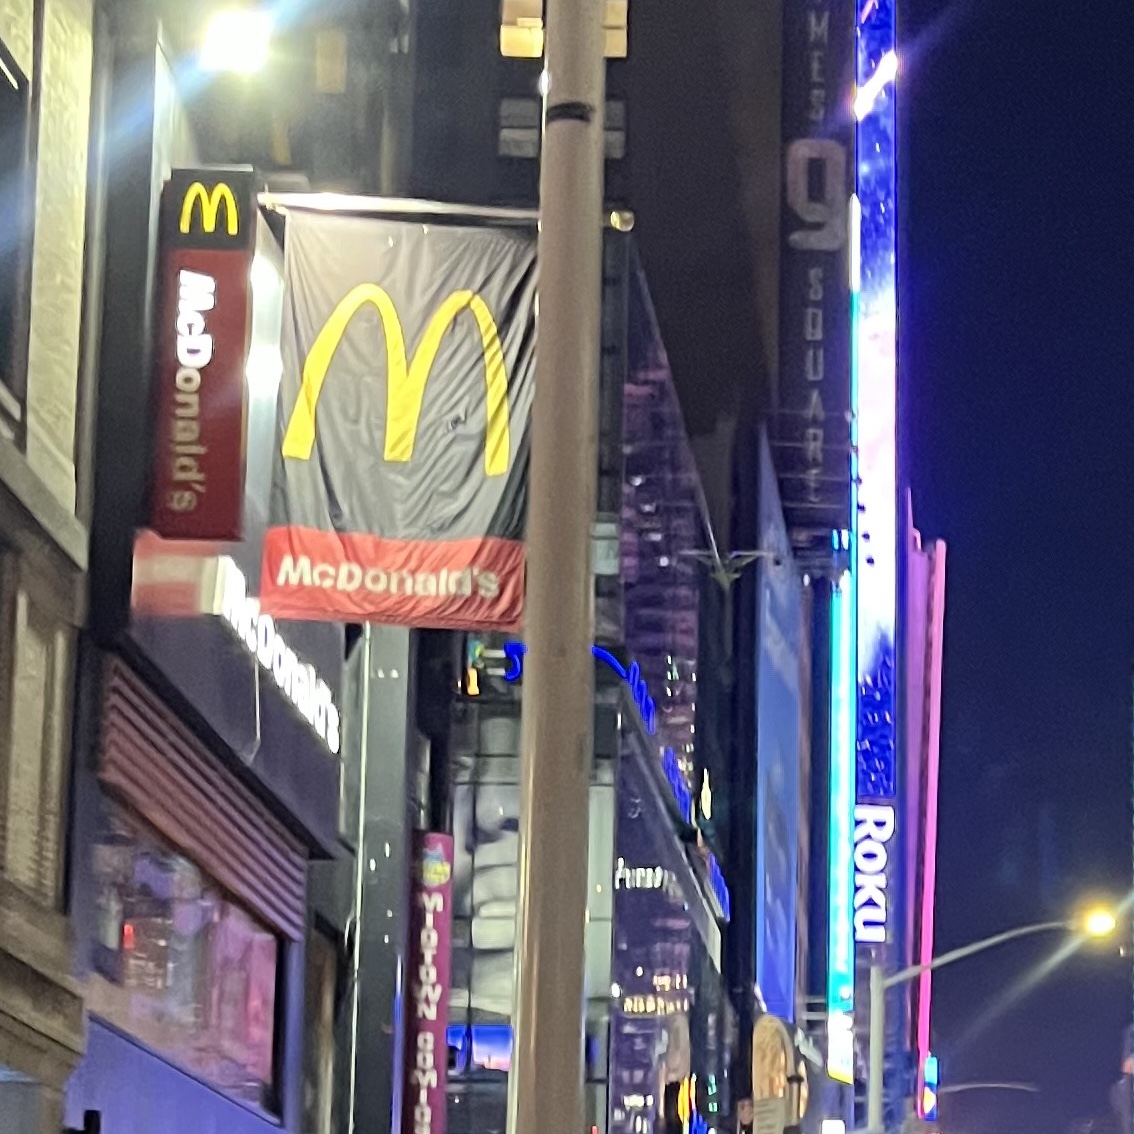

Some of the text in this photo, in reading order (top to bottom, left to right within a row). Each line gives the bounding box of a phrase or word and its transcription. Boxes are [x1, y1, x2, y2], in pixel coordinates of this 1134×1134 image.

[170, 269, 217, 512] McDonald's
[804, 268, 826, 502] SQUARE
[277, 553, 500, 599] McDonald's
